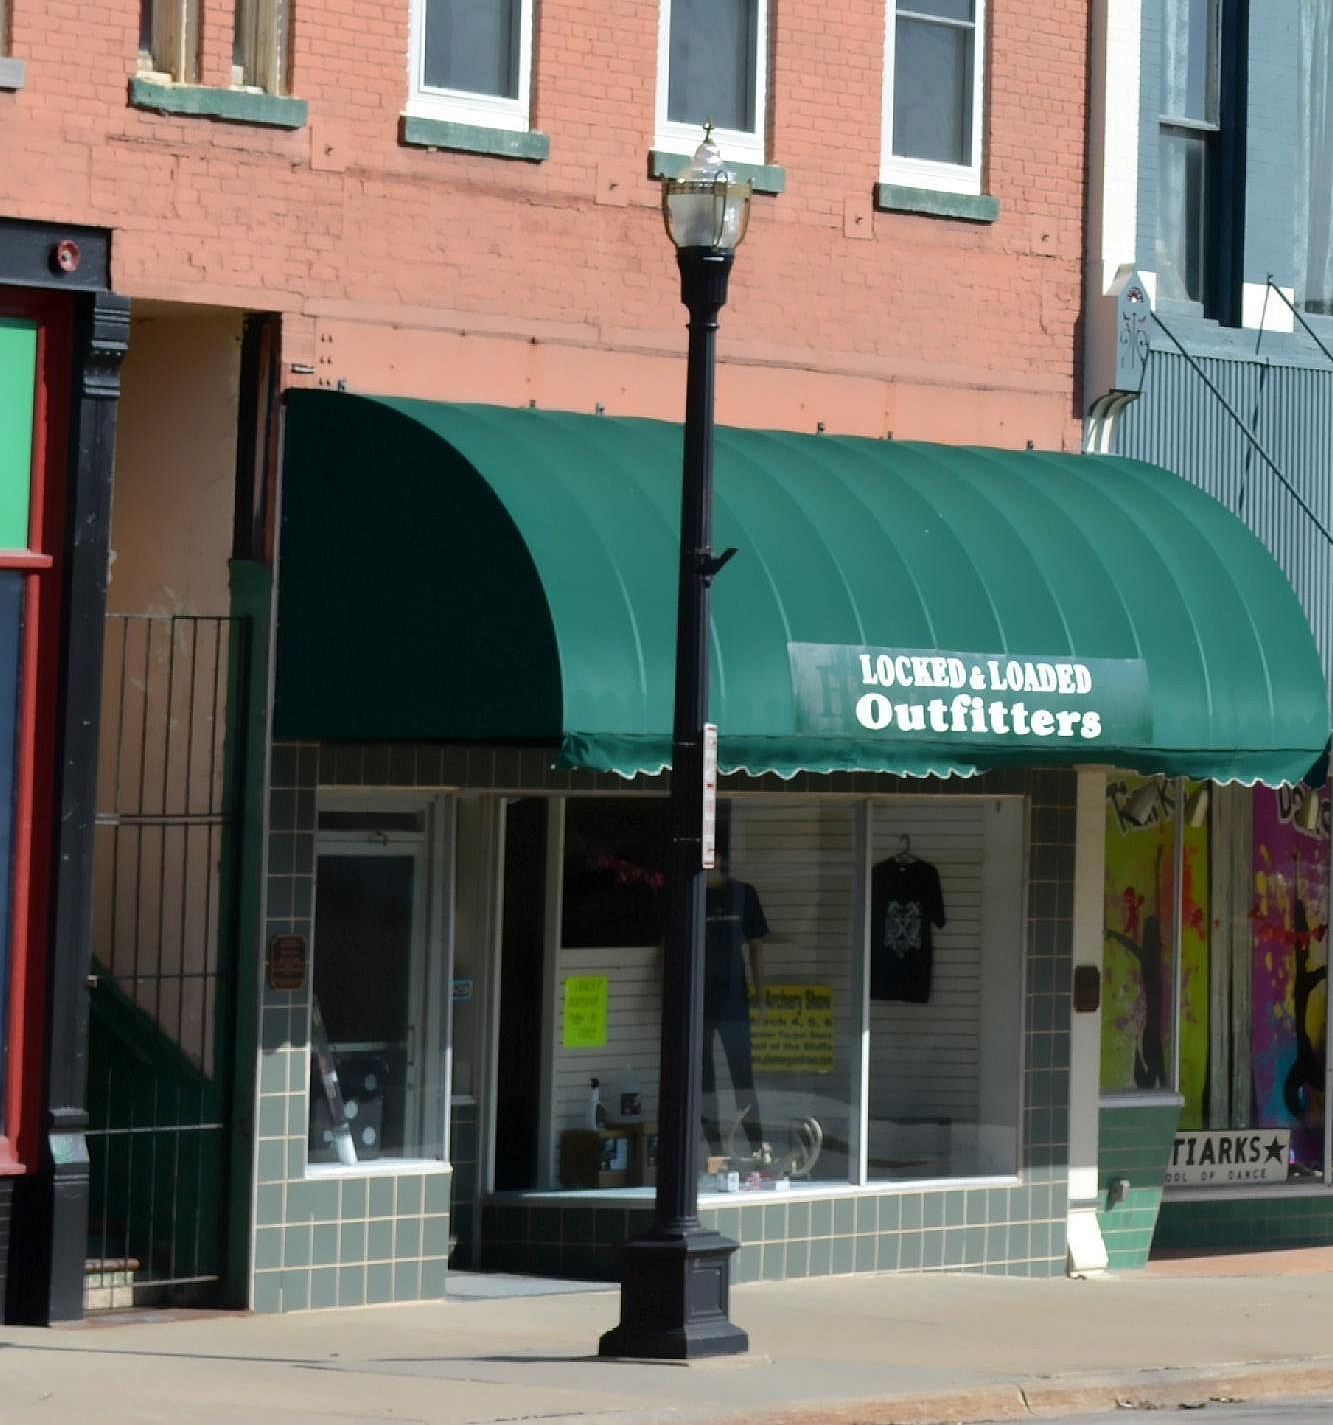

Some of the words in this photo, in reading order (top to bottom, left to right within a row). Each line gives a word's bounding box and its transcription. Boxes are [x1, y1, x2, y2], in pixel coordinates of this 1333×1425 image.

[859, 654, 966, 688] LOCKED
[969, 665, 986, 690] &
[987, 660, 1092, 694] LOADED
[855, 692, 1102, 739] Outfitters
[1201, 1171, 1216, 1181] OF
